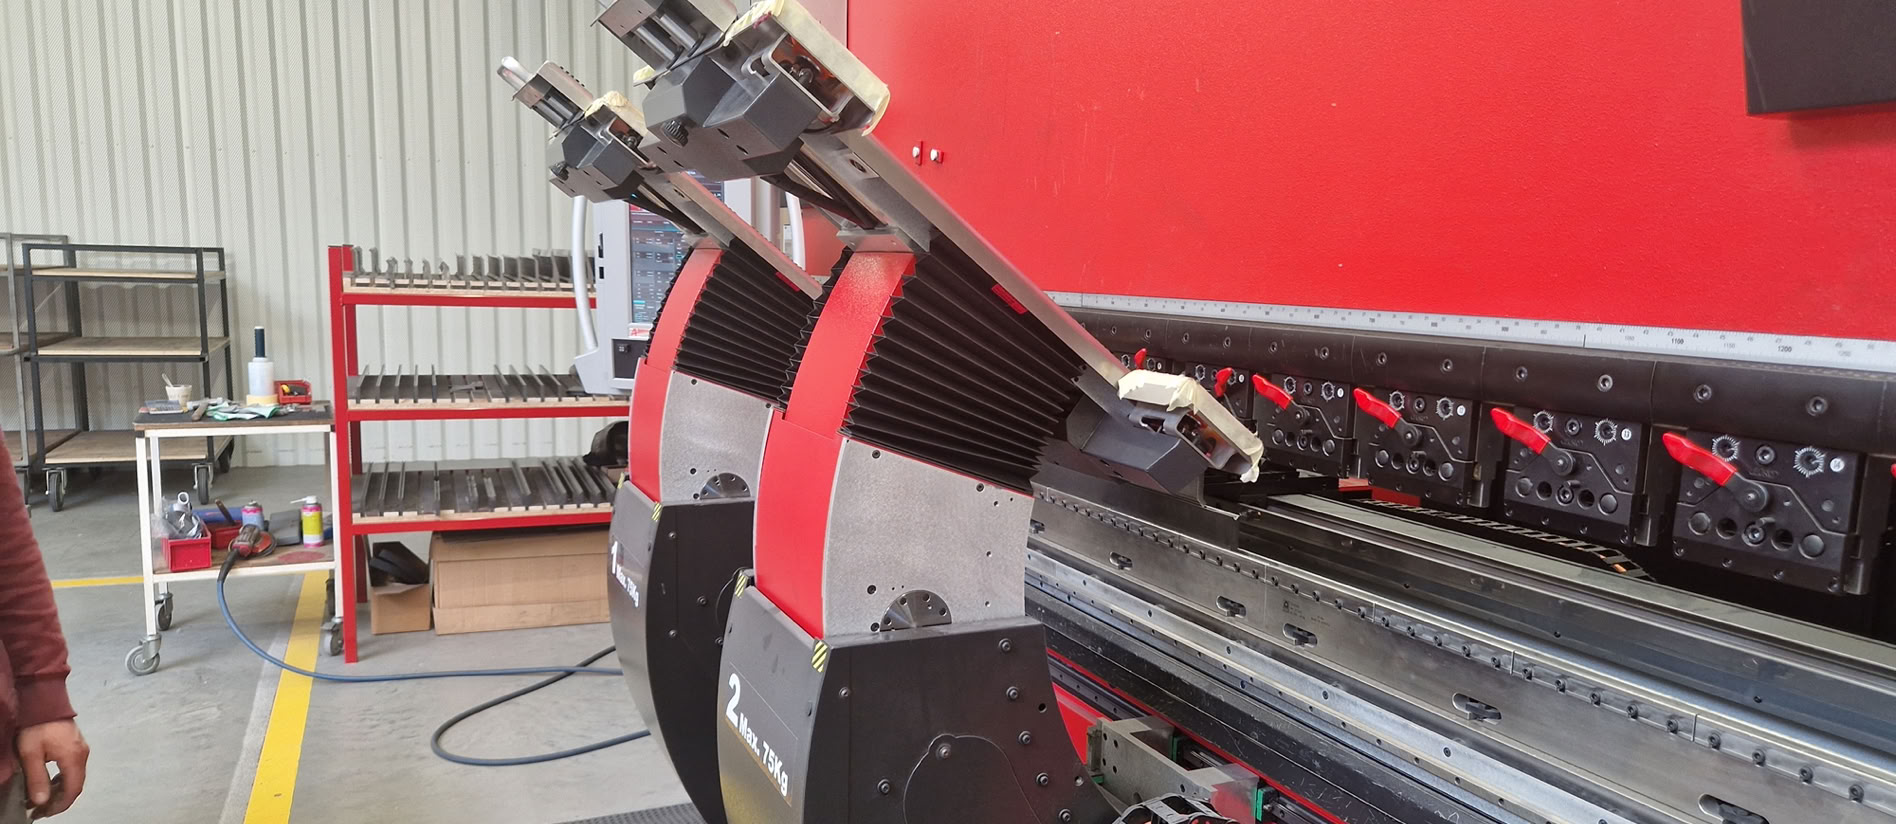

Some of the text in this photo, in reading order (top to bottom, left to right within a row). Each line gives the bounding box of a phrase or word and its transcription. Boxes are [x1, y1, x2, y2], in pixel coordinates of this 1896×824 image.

[1777, 345, 1792, 353] 1200
[611, 541, 639, 608] 1 Max. 75Kg
[725, 673, 789, 797] 2 Max. 75Kg
